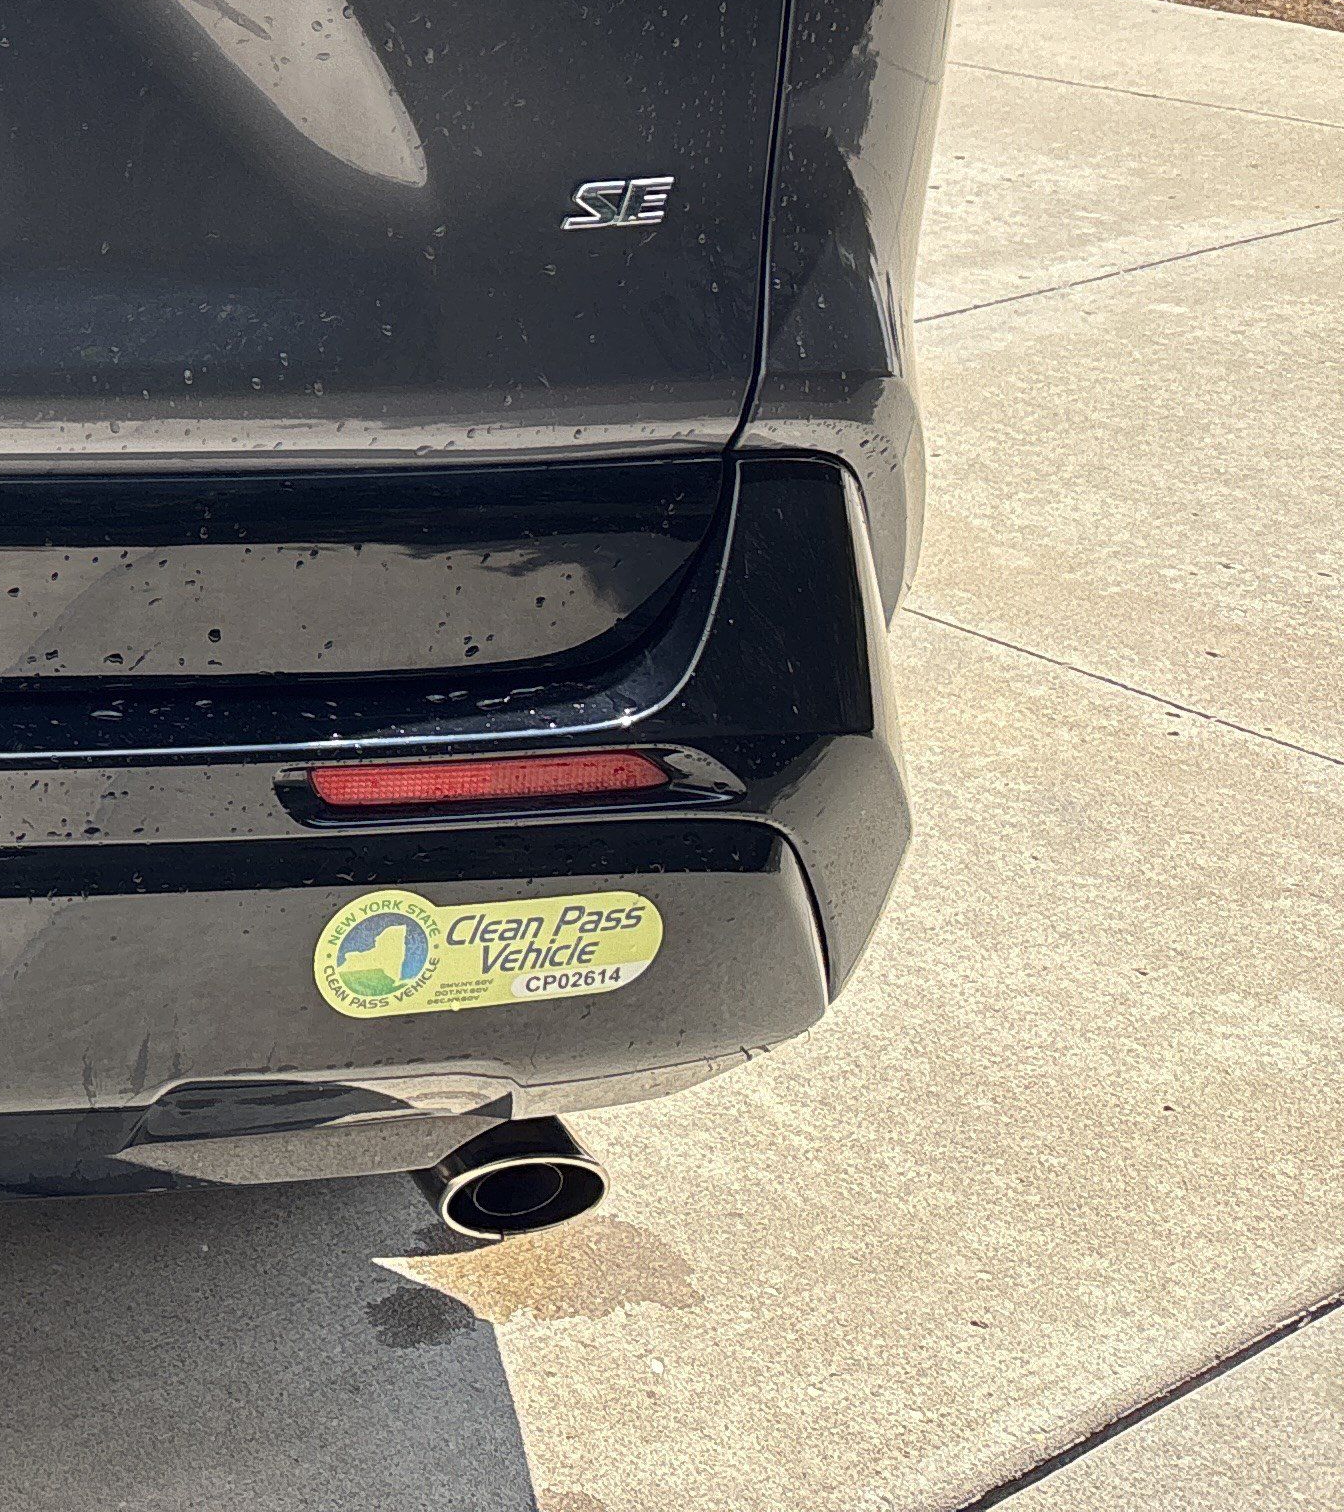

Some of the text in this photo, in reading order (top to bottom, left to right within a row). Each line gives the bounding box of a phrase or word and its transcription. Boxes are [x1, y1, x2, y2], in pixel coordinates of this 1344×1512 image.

[560, 177, 675, 230] SE
[329, 899, 441, 946] NEW YORK STATE
[446, 906, 646, 946] Clean Pass
[480, 939, 600, 974] Vehicle
[323, 956, 441, 1010] CLEAN PASS VEHICLE
[525, 967, 621, 992] CP02614
